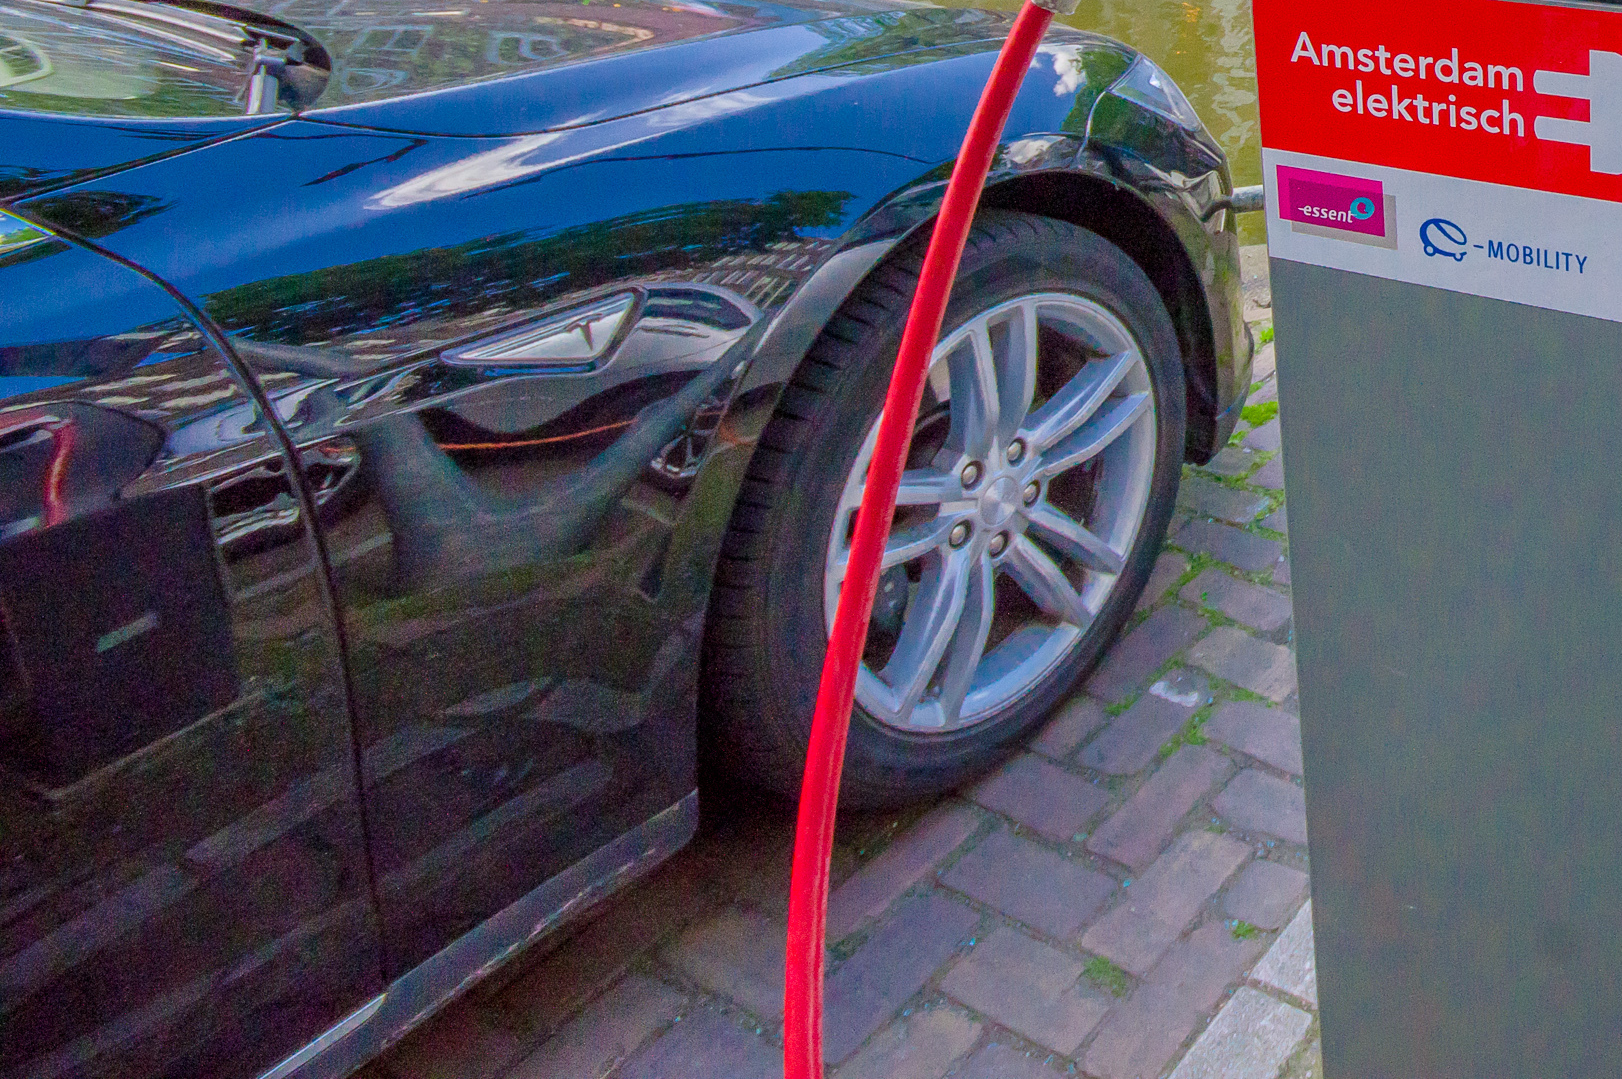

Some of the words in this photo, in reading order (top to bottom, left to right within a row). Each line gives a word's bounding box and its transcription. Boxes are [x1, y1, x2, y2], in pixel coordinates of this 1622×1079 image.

[1290, 31, 1524, 92] Amsterdam
[1332, 80, 1525, 137] elektrisch
[1303, 205, 1355, 223] essent
